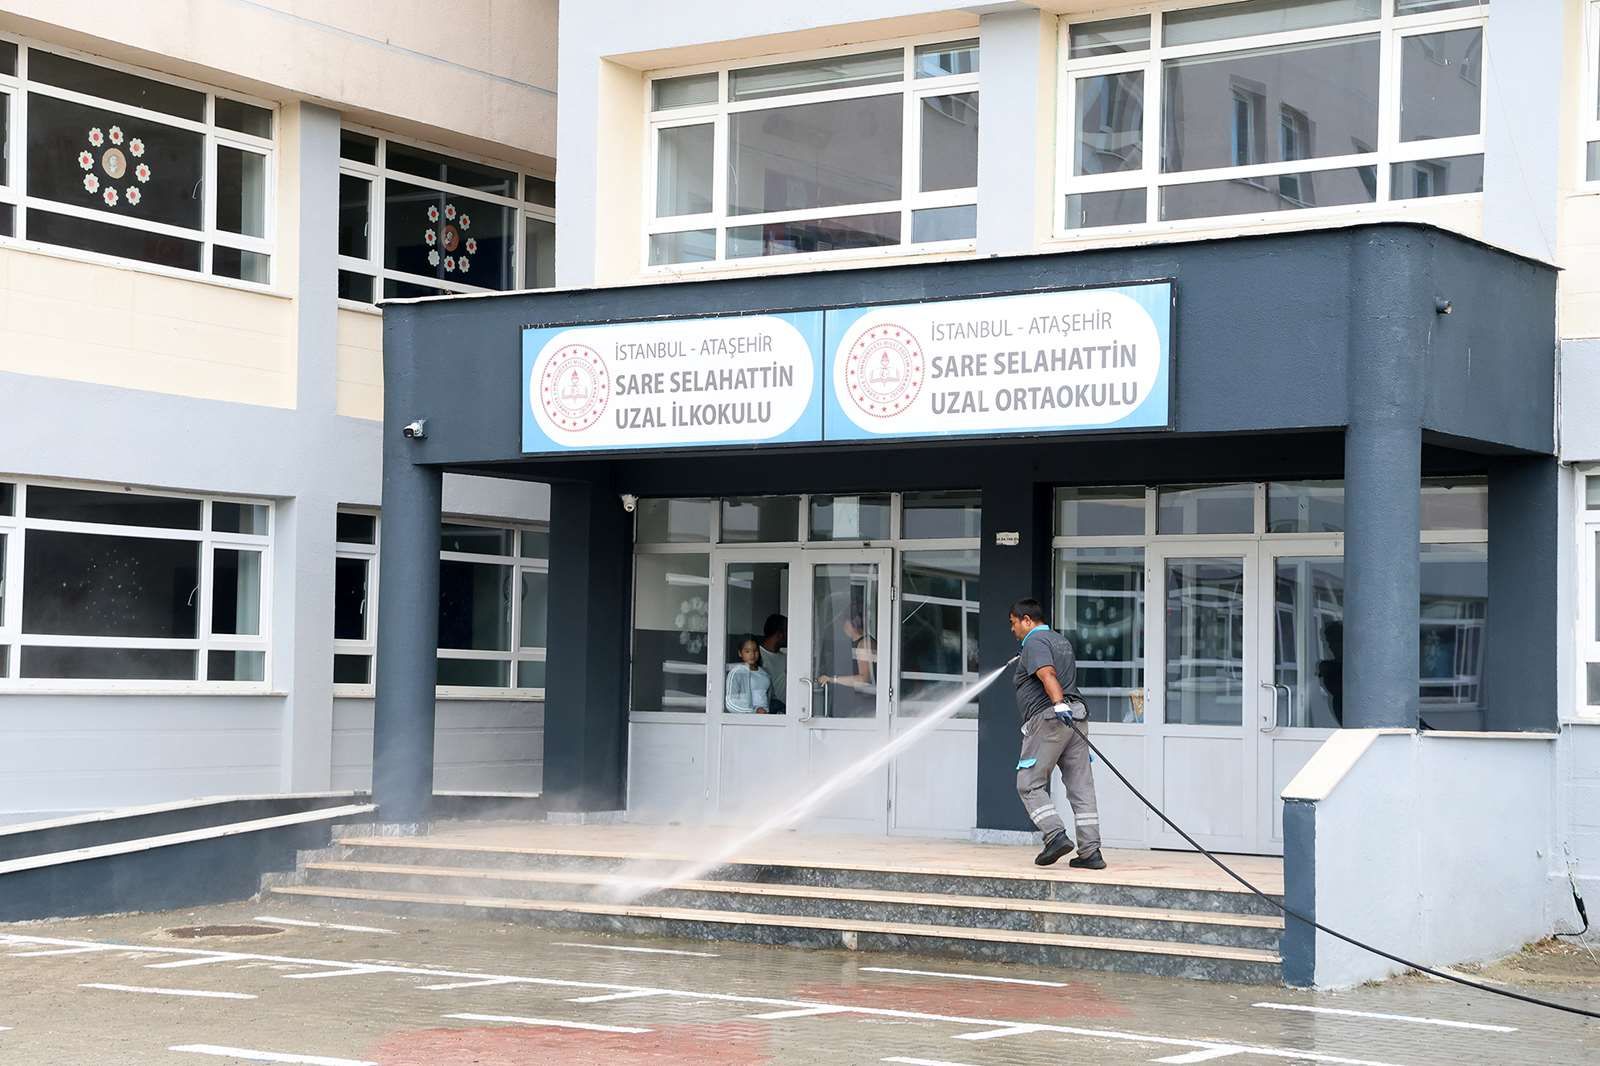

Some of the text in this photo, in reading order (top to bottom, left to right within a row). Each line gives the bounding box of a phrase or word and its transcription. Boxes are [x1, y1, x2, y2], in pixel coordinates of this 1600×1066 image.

[931, 319, 1013, 341] İSTANBUL
[1028, 308, 1112, 337] ATAŞEHİR
[615, 341, 687, 361] İSTANBUL
[700, 333, 773, 359] ATAŞEHİR
[931, 353, 987, 379] SARE
[994, 340, 1137, 376] SELAHATTİN
[615, 372, 665, 396] SARE
[670, 361, 793, 393] SELAHATTİN
[931, 381, 1138, 415] UZAL ORTAOKULU
[615, 401, 772, 430] UZAL İLKOKULU
